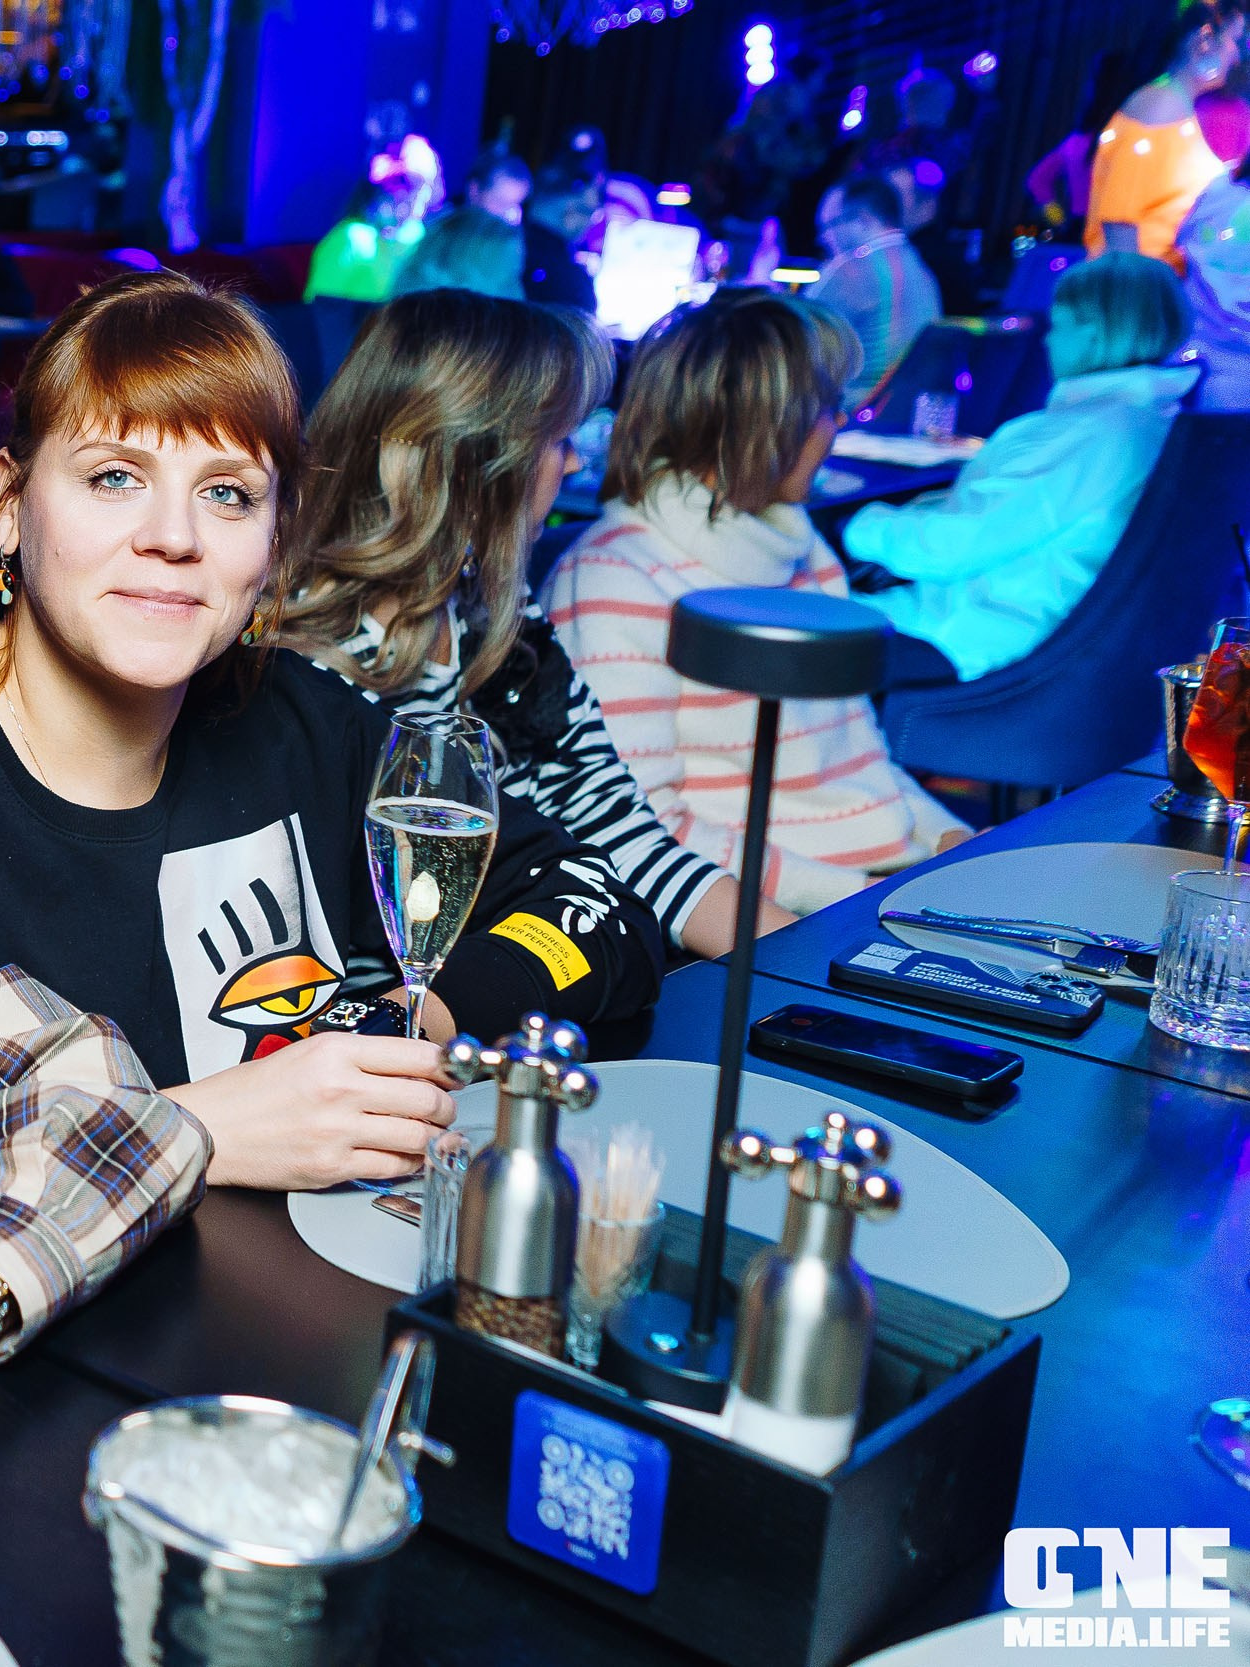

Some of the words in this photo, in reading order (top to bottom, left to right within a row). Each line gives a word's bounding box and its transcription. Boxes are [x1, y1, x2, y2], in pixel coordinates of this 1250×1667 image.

[499, 923, 524, 935] OVER
[524, 933, 572, 982] PERFECTION
[523, 922, 571, 959] PROGRESS
